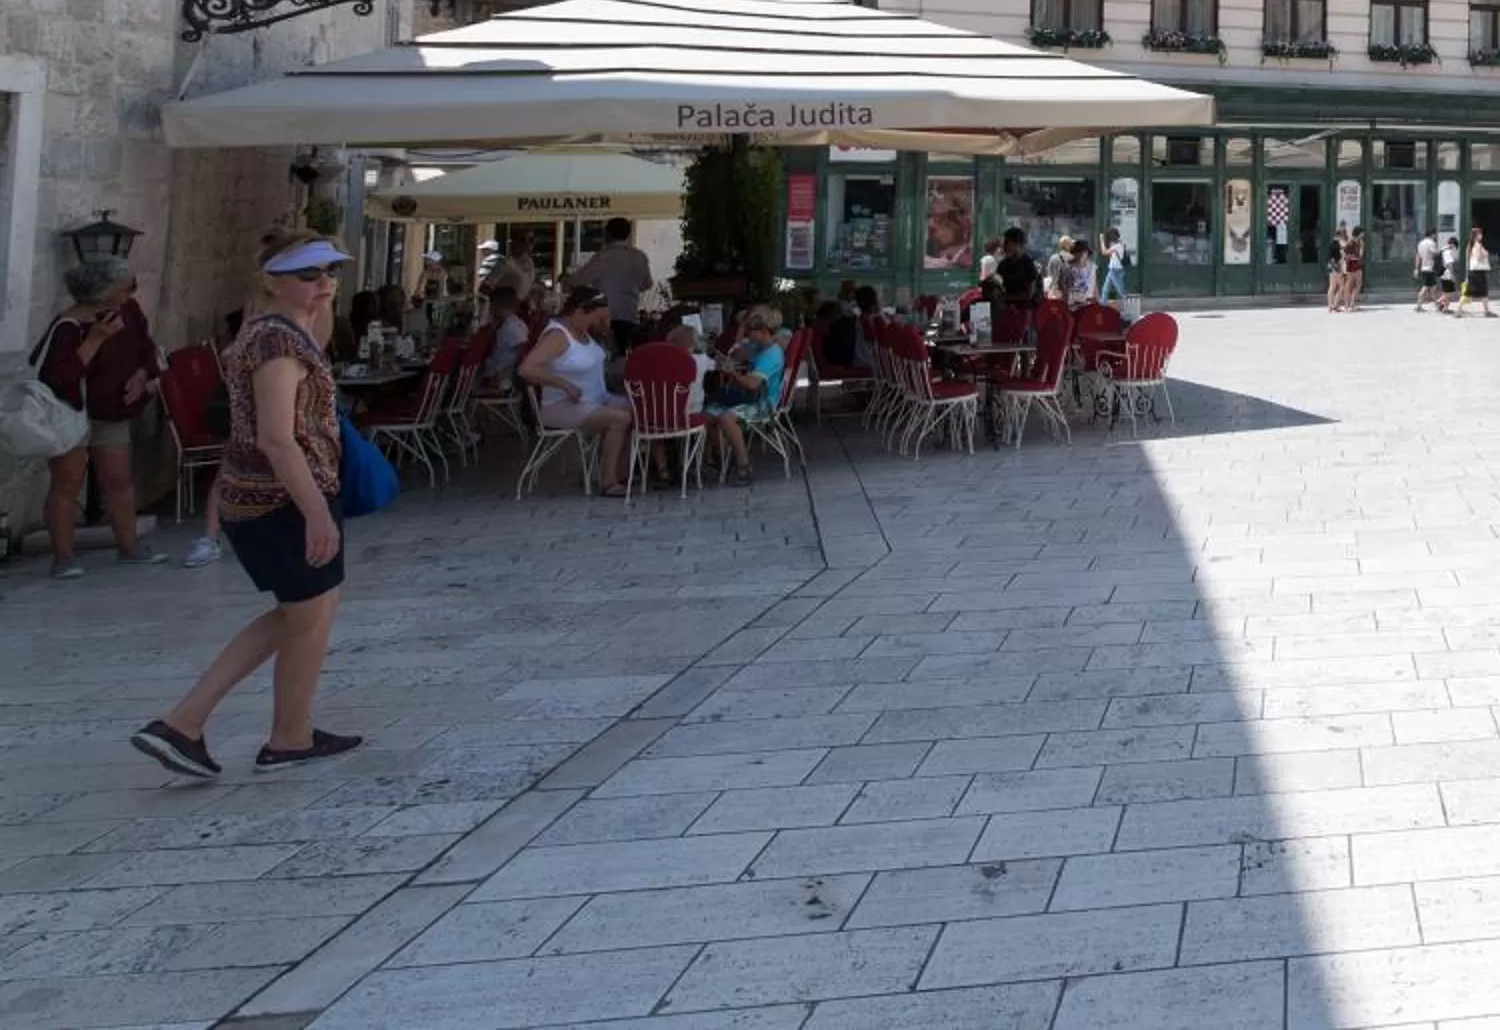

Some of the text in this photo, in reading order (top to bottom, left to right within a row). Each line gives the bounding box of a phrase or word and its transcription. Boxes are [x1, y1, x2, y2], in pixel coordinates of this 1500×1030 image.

[677, 102, 873, 129] Palača Judita
[516, 196, 612, 211] PAULANER
